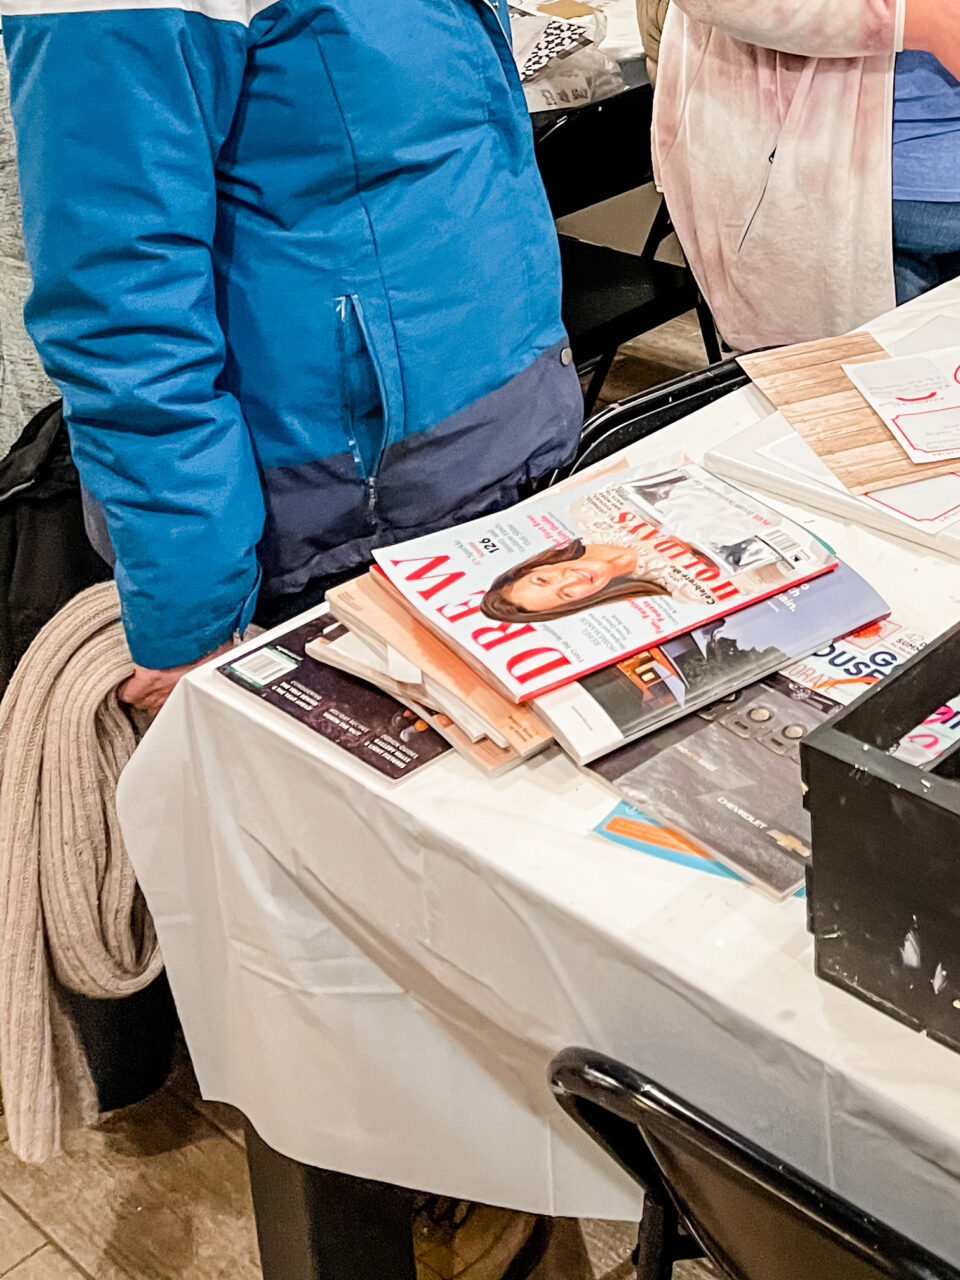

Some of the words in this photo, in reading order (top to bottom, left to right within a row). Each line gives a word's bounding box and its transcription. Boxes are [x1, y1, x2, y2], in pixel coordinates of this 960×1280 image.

[480, 538, 499, 553] 126
[610, 510, 741, 602] HOLIDAYS
[390, 555, 572, 685] DREW
[718, 797, 767, 829] CHEVROLET
